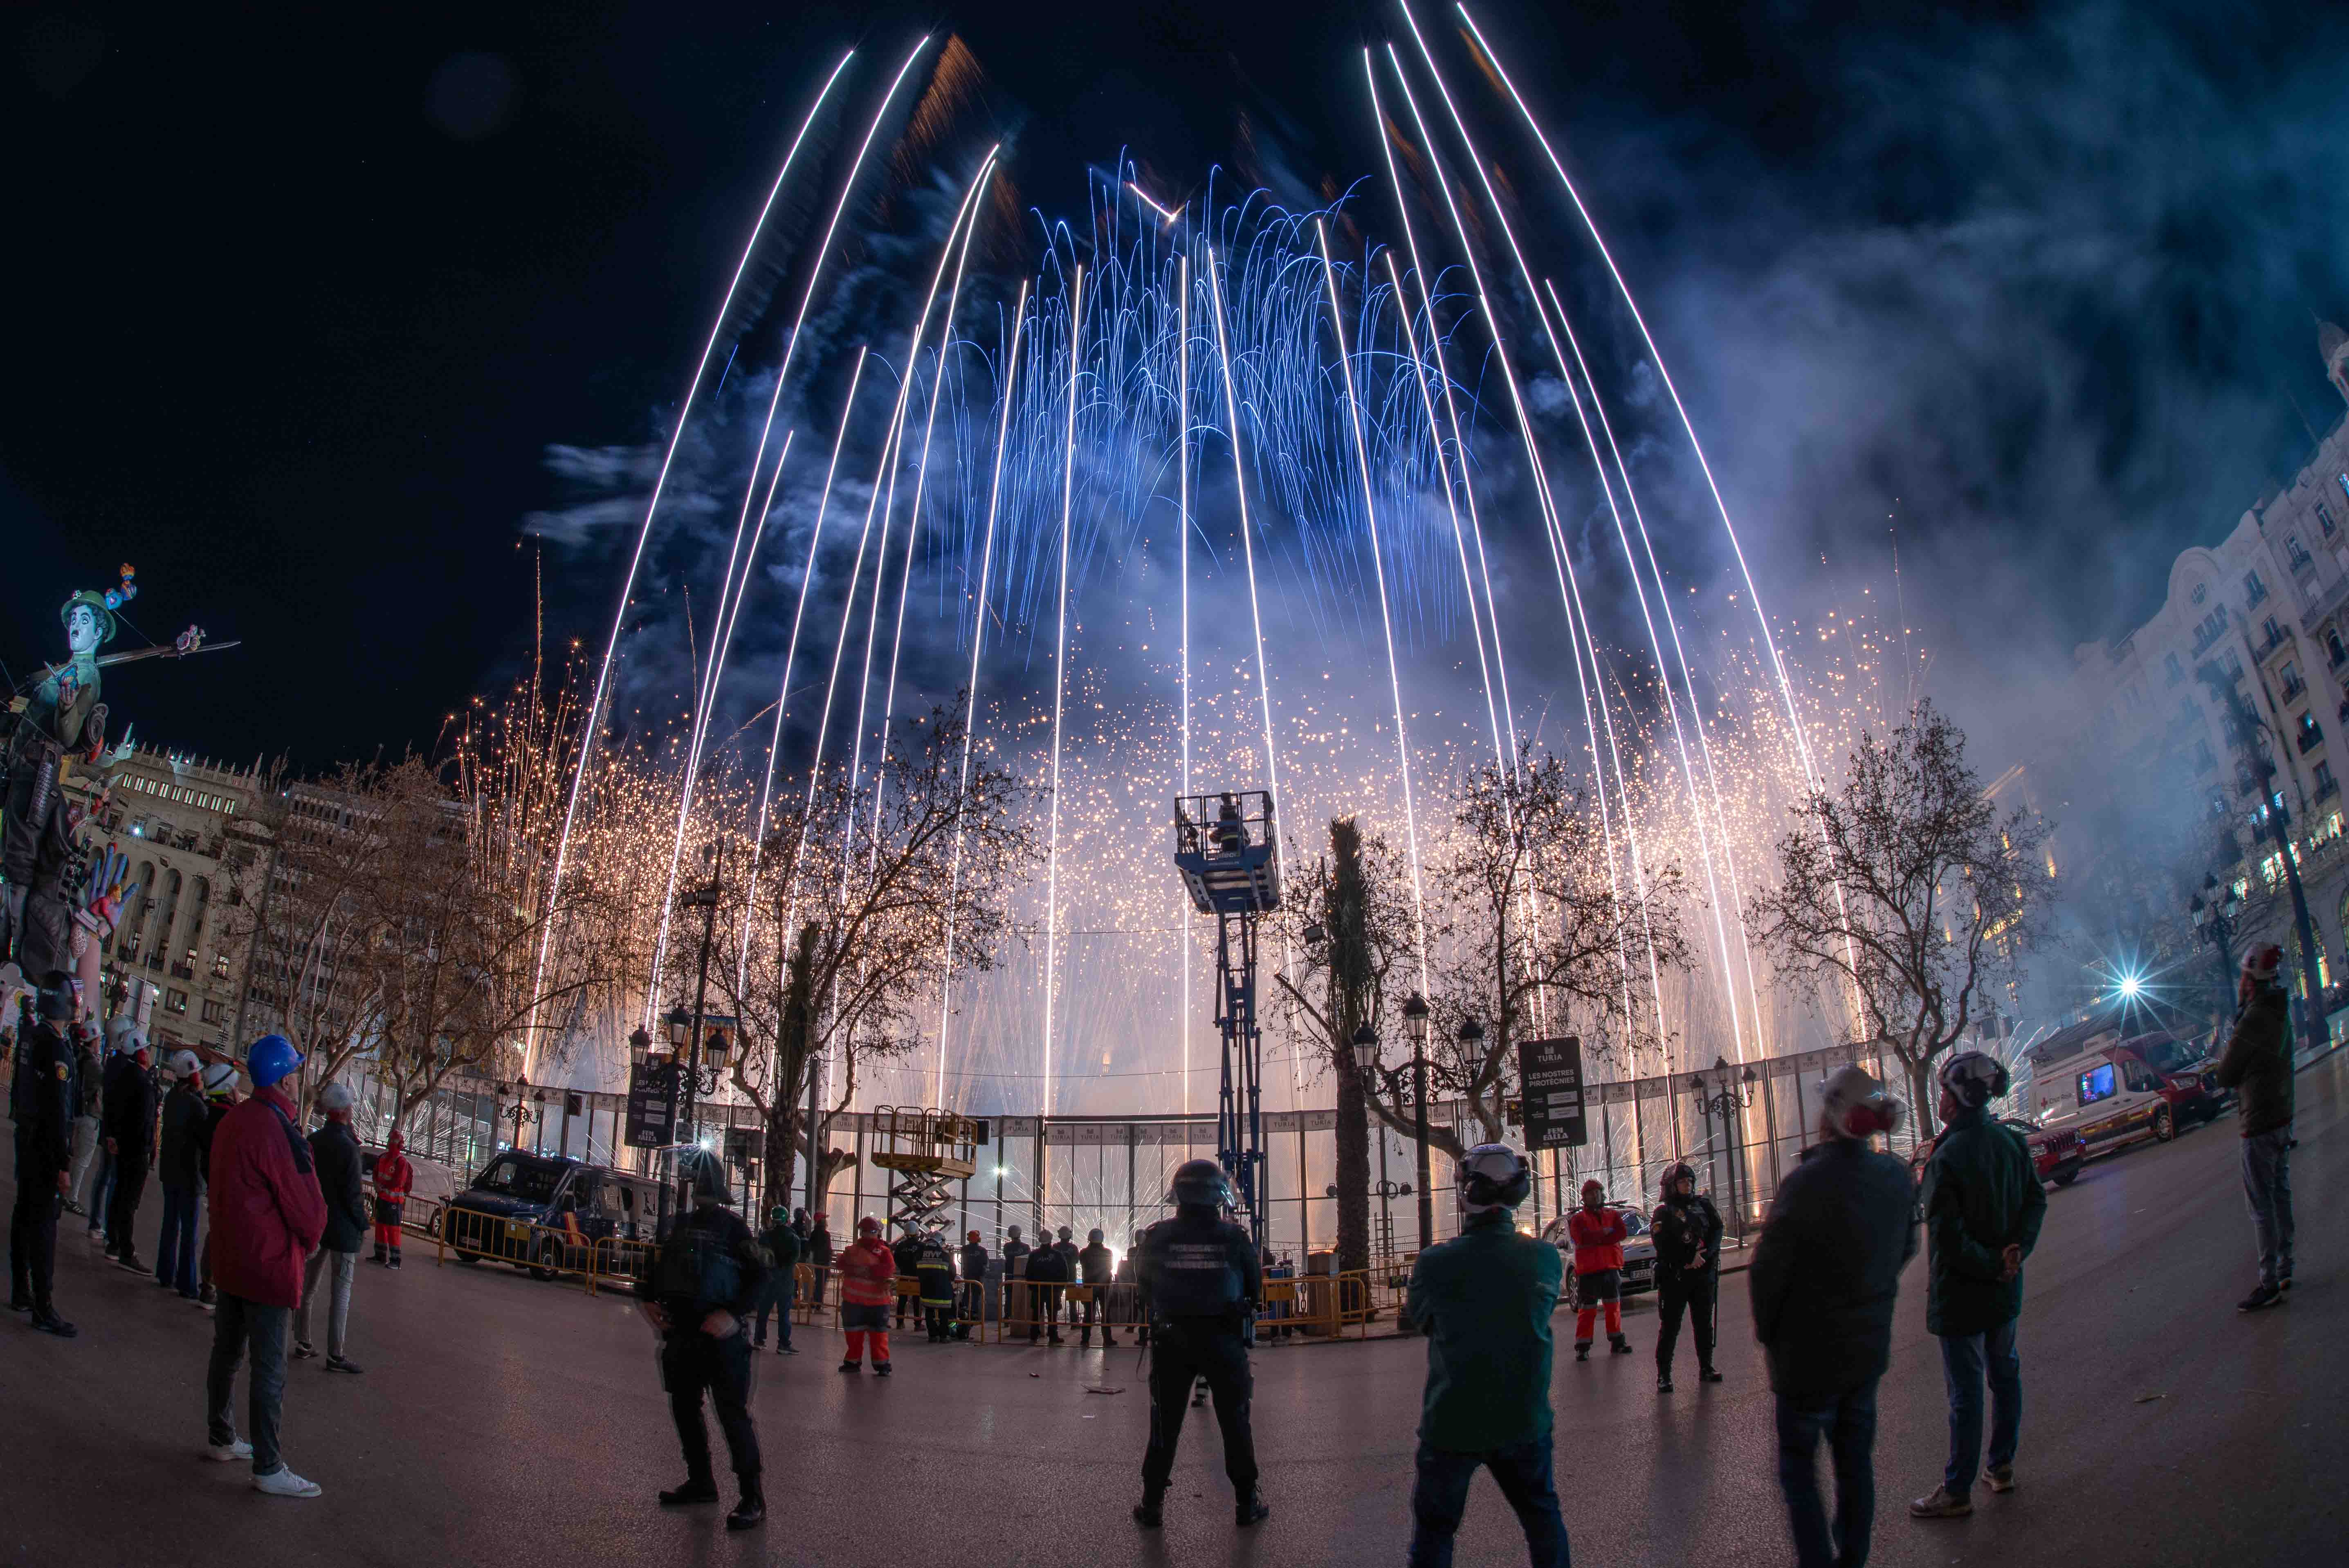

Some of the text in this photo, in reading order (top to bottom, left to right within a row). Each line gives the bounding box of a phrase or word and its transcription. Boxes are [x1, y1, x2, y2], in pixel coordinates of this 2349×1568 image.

[1537, 1054, 1563, 1063] TURIA
[1542, 1069, 1574, 1078] NOSTRES
[1543, 1132, 1568, 1141] FALLA
